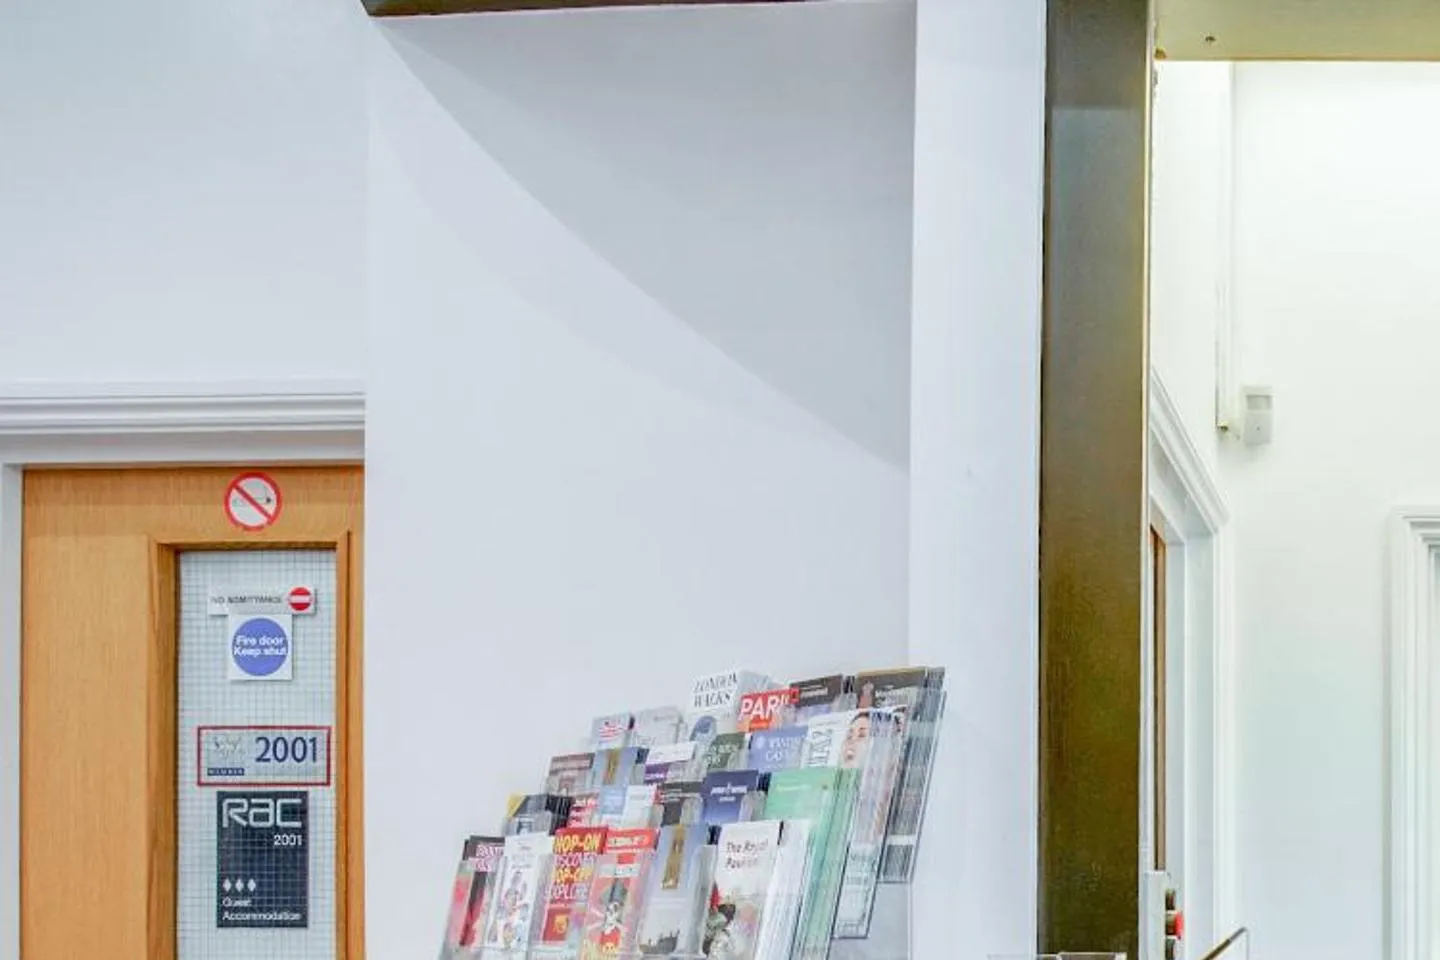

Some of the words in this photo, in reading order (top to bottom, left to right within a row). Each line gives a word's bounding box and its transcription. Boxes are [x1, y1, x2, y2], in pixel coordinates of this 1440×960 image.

[236, 635, 257, 646] Fire
[259, 634, 284, 646] door
[234, 646, 261, 658] Keep
[264, 646, 287, 656] shut
[255, 736, 318, 763] 2001
[273, 834, 303, 846] 2001
[553, 832, 602, 853] HOP-ON
[222, 910, 302, 921] Accommodation
